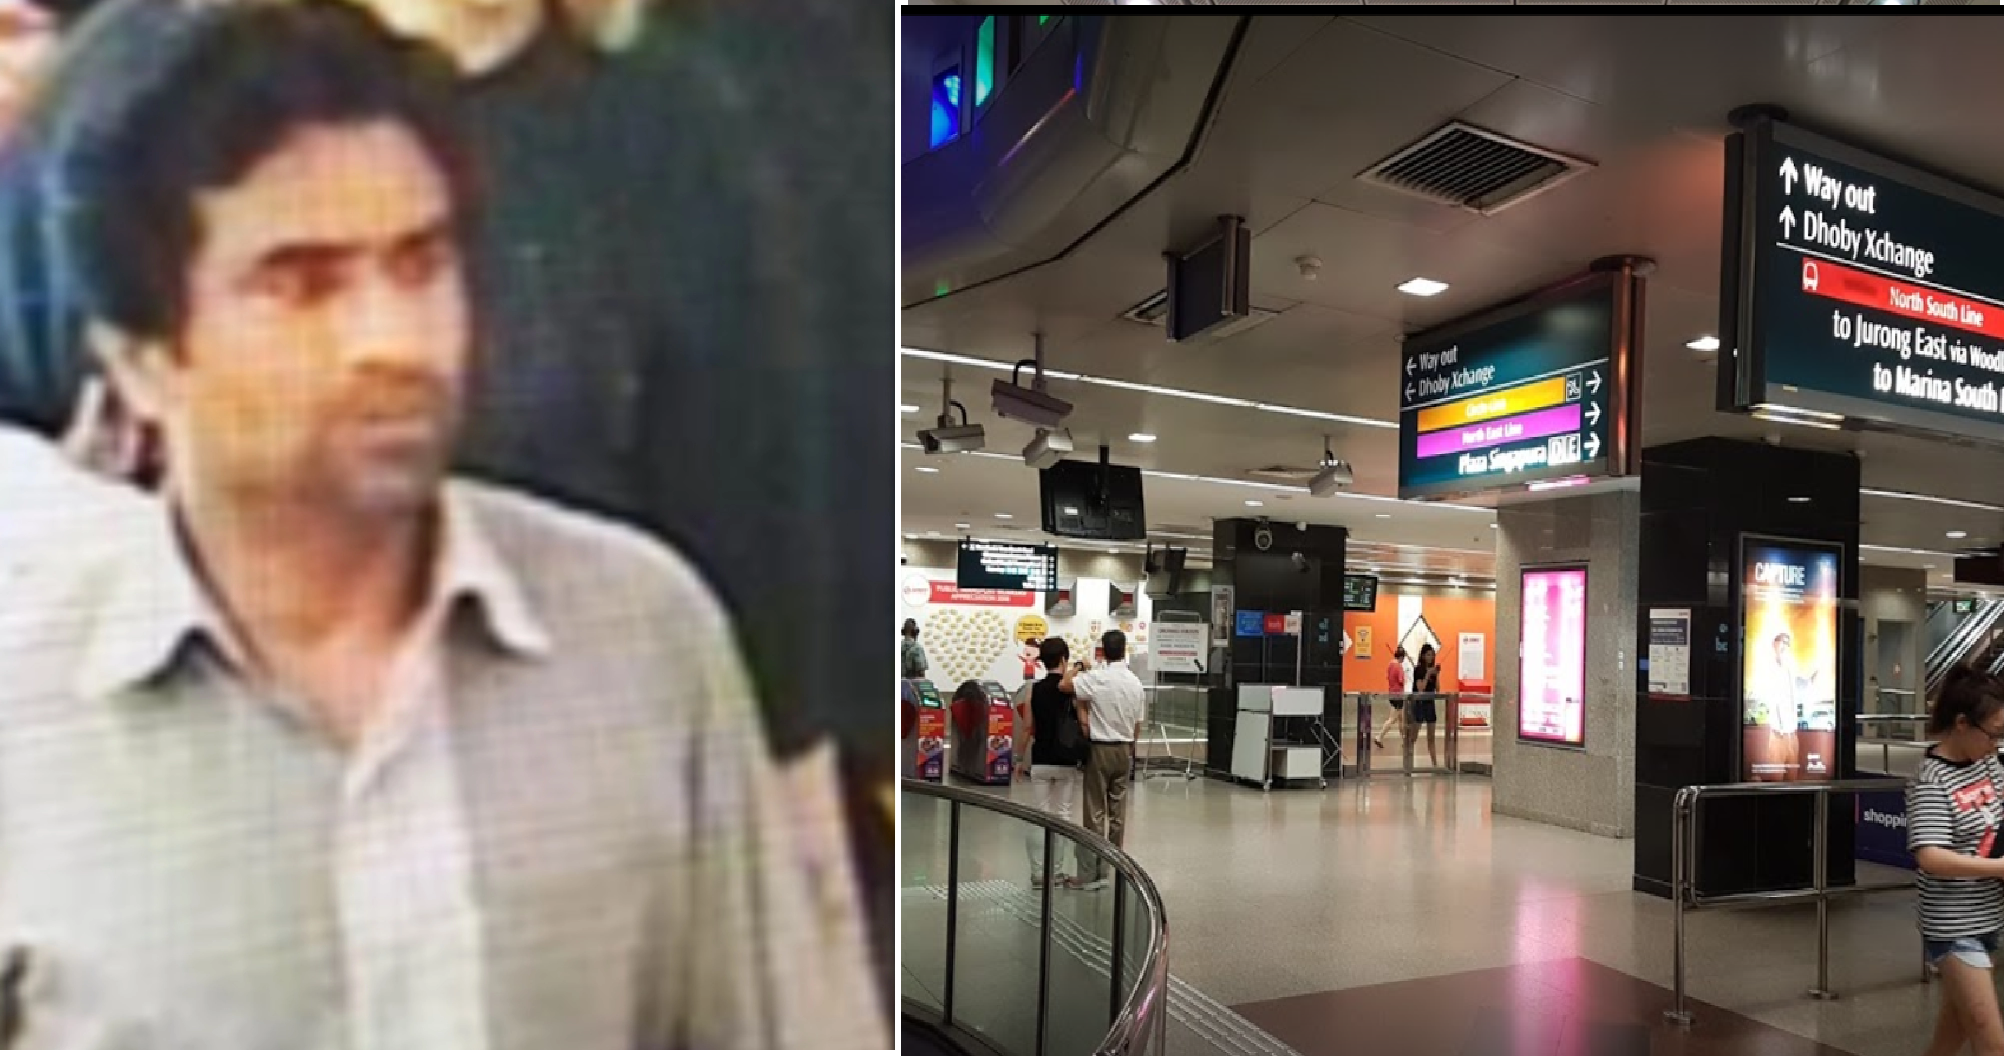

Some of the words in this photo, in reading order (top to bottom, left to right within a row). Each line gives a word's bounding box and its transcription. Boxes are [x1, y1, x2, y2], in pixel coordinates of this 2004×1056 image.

[1803, 163, 1841, 210] Way
[1845, 184, 1876, 213] out
[1803, 210, 1861, 260] Dhoby
[1864, 228, 1934, 277] Xchange
[1890, 286, 1924, 313] North
[1927, 296, 1958, 322] South
[1960, 304, 1984, 327] Line
[1419, 352, 1440, 371] Way
[1441, 345, 1458, 366] out
[1832, 309, 1851, 339] to
[1854, 313, 1911, 359] Jurong
[1914, 327, 1947, 361] East
[1950, 339, 1967, 365] via
[1418, 373, 1449, 396] Dhoby
[1451, 365, 1495, 389] Xchange
[1873, 361, 1892, 391] to
[1895, 365, 1951, 403] Marina
[1955, 376, 1998, 413] South
[1755, 562, 1805, 586] CAPTURE
